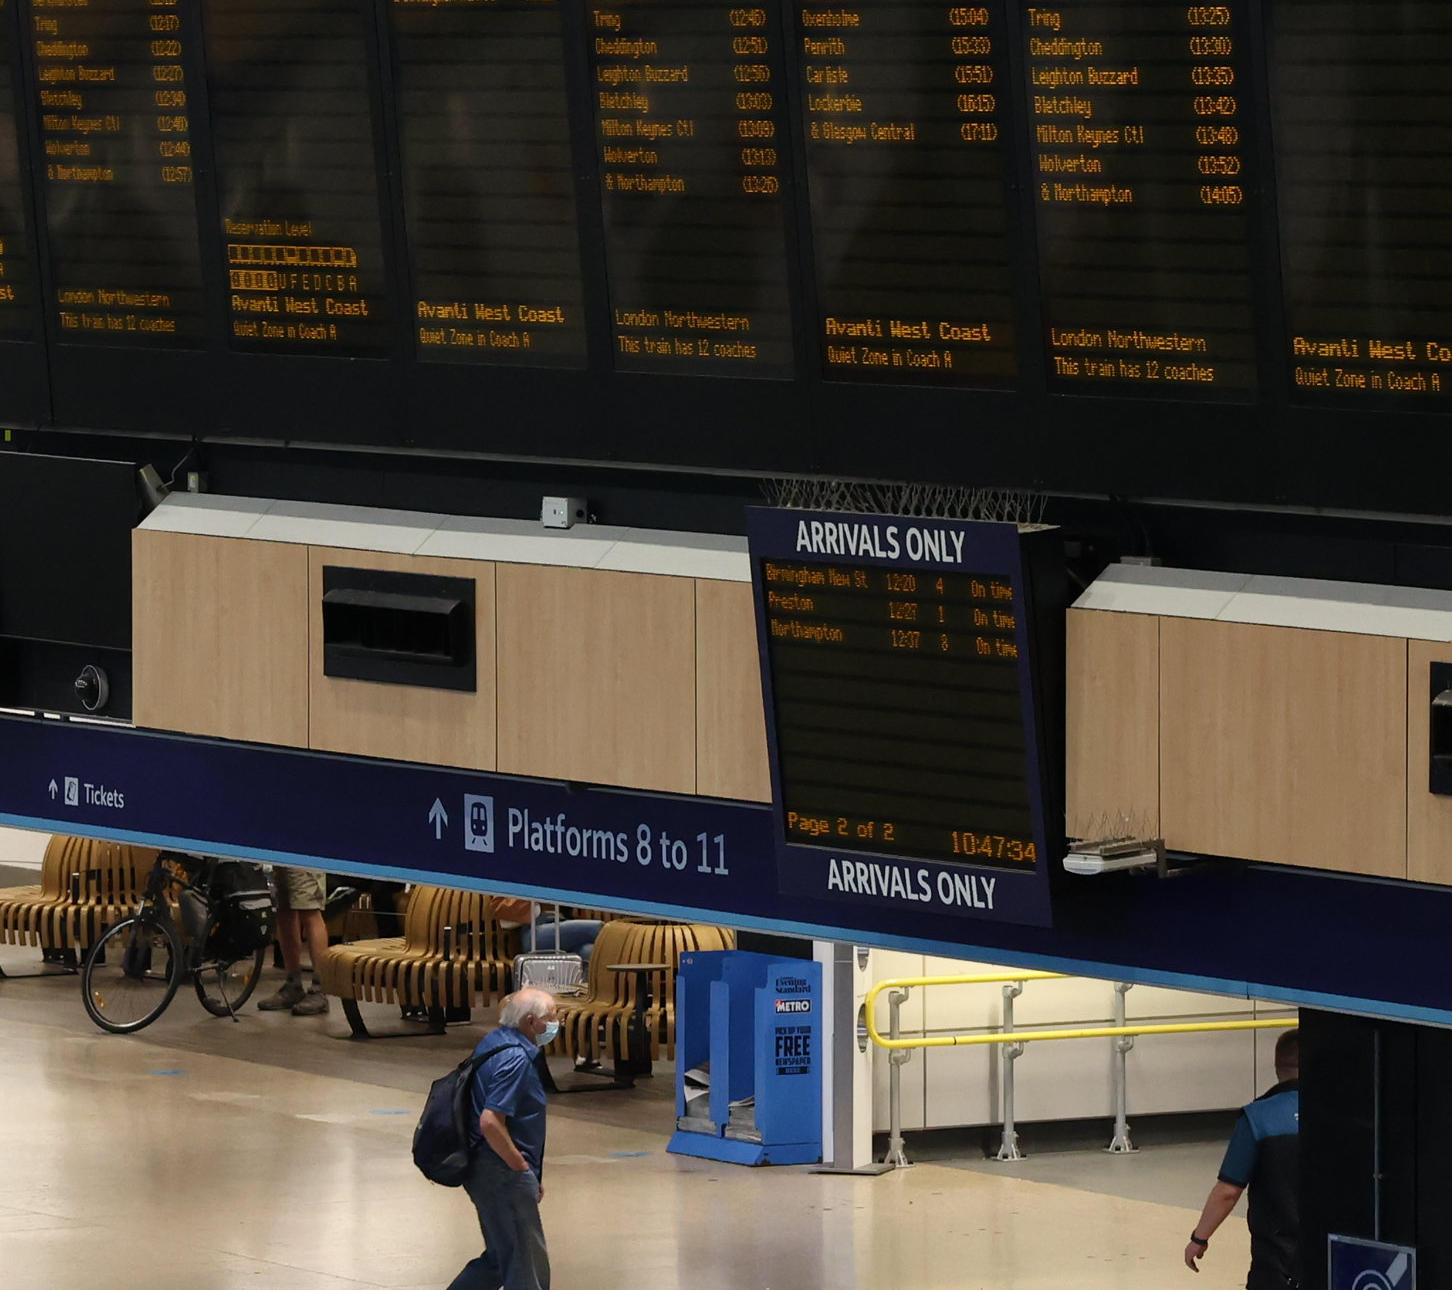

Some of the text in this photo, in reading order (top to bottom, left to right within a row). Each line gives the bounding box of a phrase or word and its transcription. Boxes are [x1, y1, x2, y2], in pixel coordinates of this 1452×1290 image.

[797, 521, 965, 562] ARRIVALS ONLY
[766, 563, 825, 587] Birmingham
[830, 569, 850, 587] New
[855, 572, 868, 589] St
[887, 573, 916, 591] 12:20
[936, 578, 943, 593] 4
[972, 581, 985, 598] On
[84, 783, 124, 808] Tickets
[508, 808, 728, 875] Platforms 8 to 11
[788, 812, 1036, 862] Page 2 of 2 10:47:34
[828, 859, 995, 909] ARRIVALS ONLY
[777, 1001, 809, 1012] METRO
[776, 1035, 810, 1056] FREE
